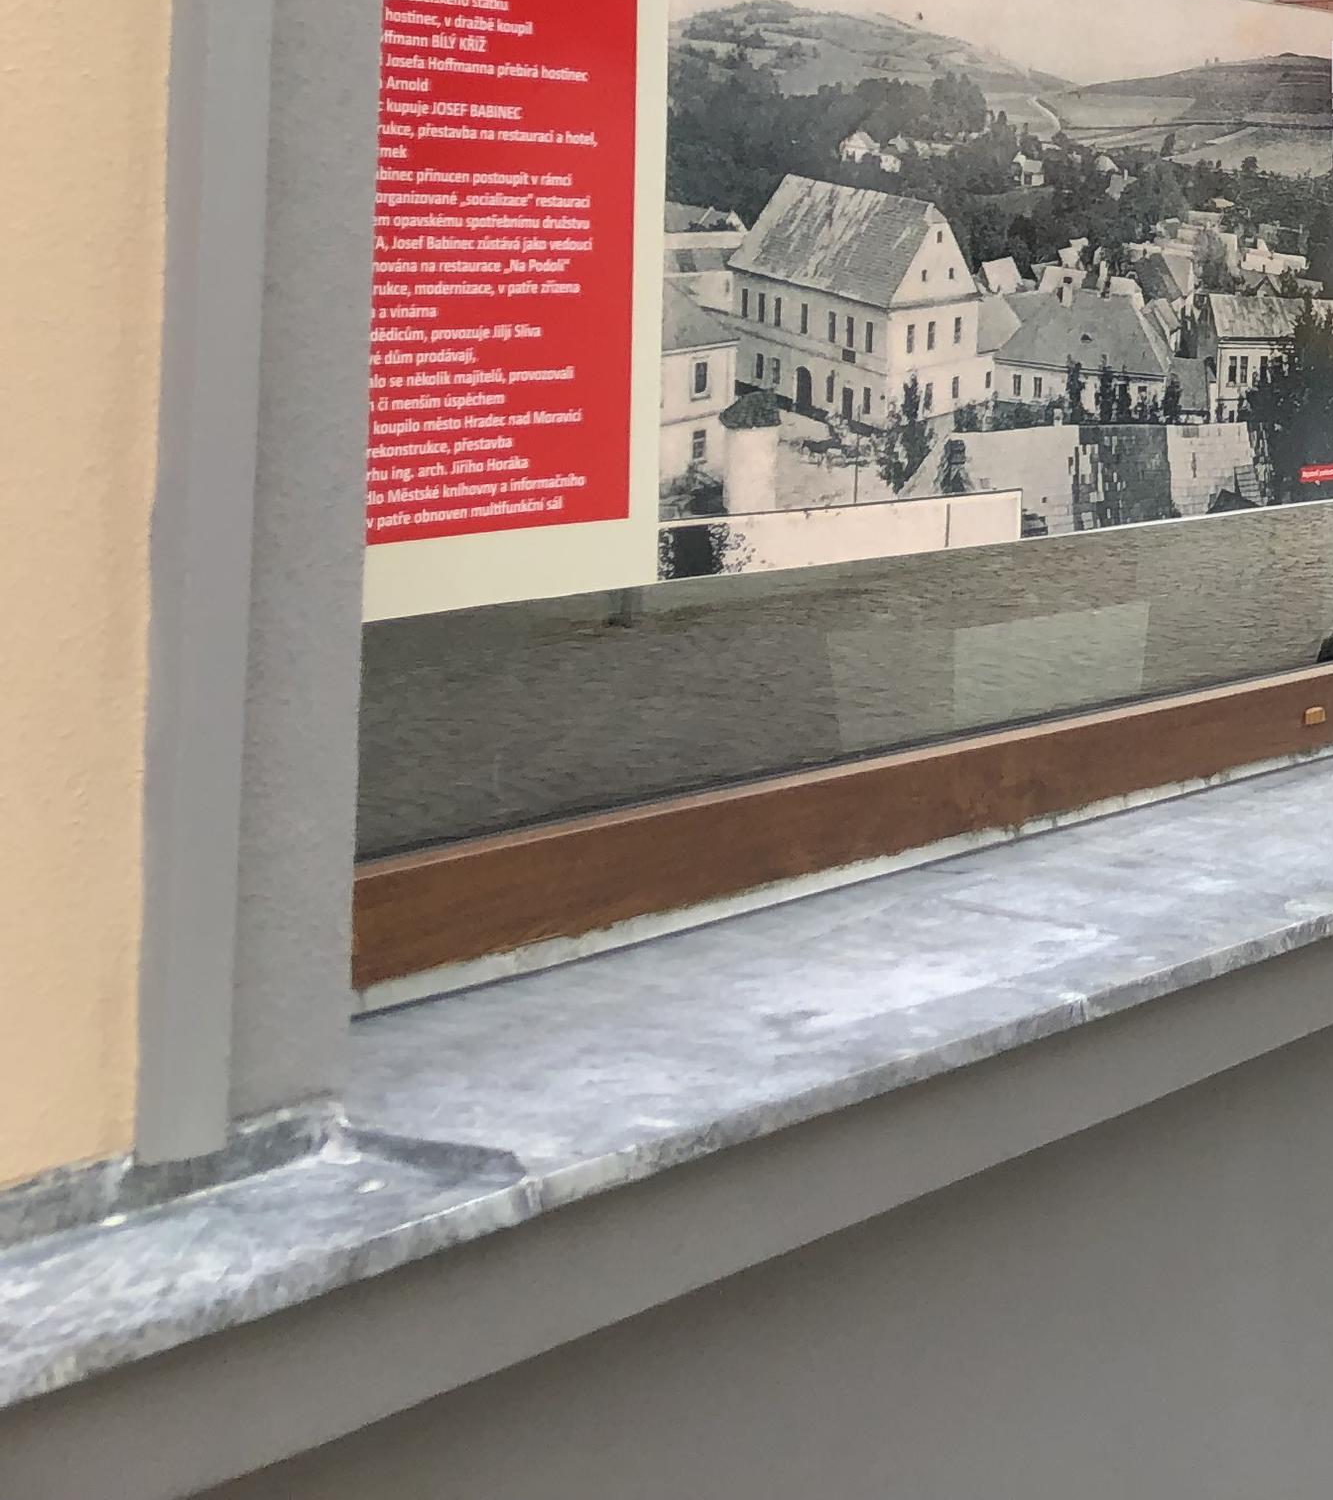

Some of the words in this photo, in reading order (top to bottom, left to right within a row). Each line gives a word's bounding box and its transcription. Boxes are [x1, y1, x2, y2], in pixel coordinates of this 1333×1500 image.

[443, 16, 452, 27] v
[431, 31, 457, 49] BÍLÝ
[458, 34, 488, 52] KŘÍŽ
[385, 53, 425, 69] Josefa
[427, 56, 495, 75] Hoffmanna
[386, 75, 430, 91] Arnold
[386, 98, 430, 117] kupuje
[431, 101, 469, 116] JOSEF
[469, 103, 524, 120] BABINEC
[416, 123, 478, 140] přestavba
[479, 129, 495, 140] na
[555, 132, 564, 143] a
[415, 168, 470, 184] přinucen
[529, 175, 538, 185] v
[391, 235, 424, 250] Josef
[426, 235, 477, 250] Babinec
[420, 261, 436, 272] na
[439, 260, 502, 273] restaurace
[413, 280, 496, 297] modernizace,
[497, 282, 505, 294] v
[378, 307, 387, 319] a
[429, 324, 490, 342] provozuje
[383, 350, 414, 365] dům
[388, 376, 404, 388] se
[405, 371, 451, 387] několik
[373, 418, 421, 437] koupilo
[423, 416, 462, 431] město
[463, 412, 507, 429] Hradec
[508, 411, 530, 426] nad
[453, 435, 514, 455] přestavba
[390, 465, 415, 483] ing.
[417, 461, 449, 478] arch.
[441, 480, 498, 500] knihovny
[499, 483, 509, 493] a
[413, 507, 469, 525] obnoven
